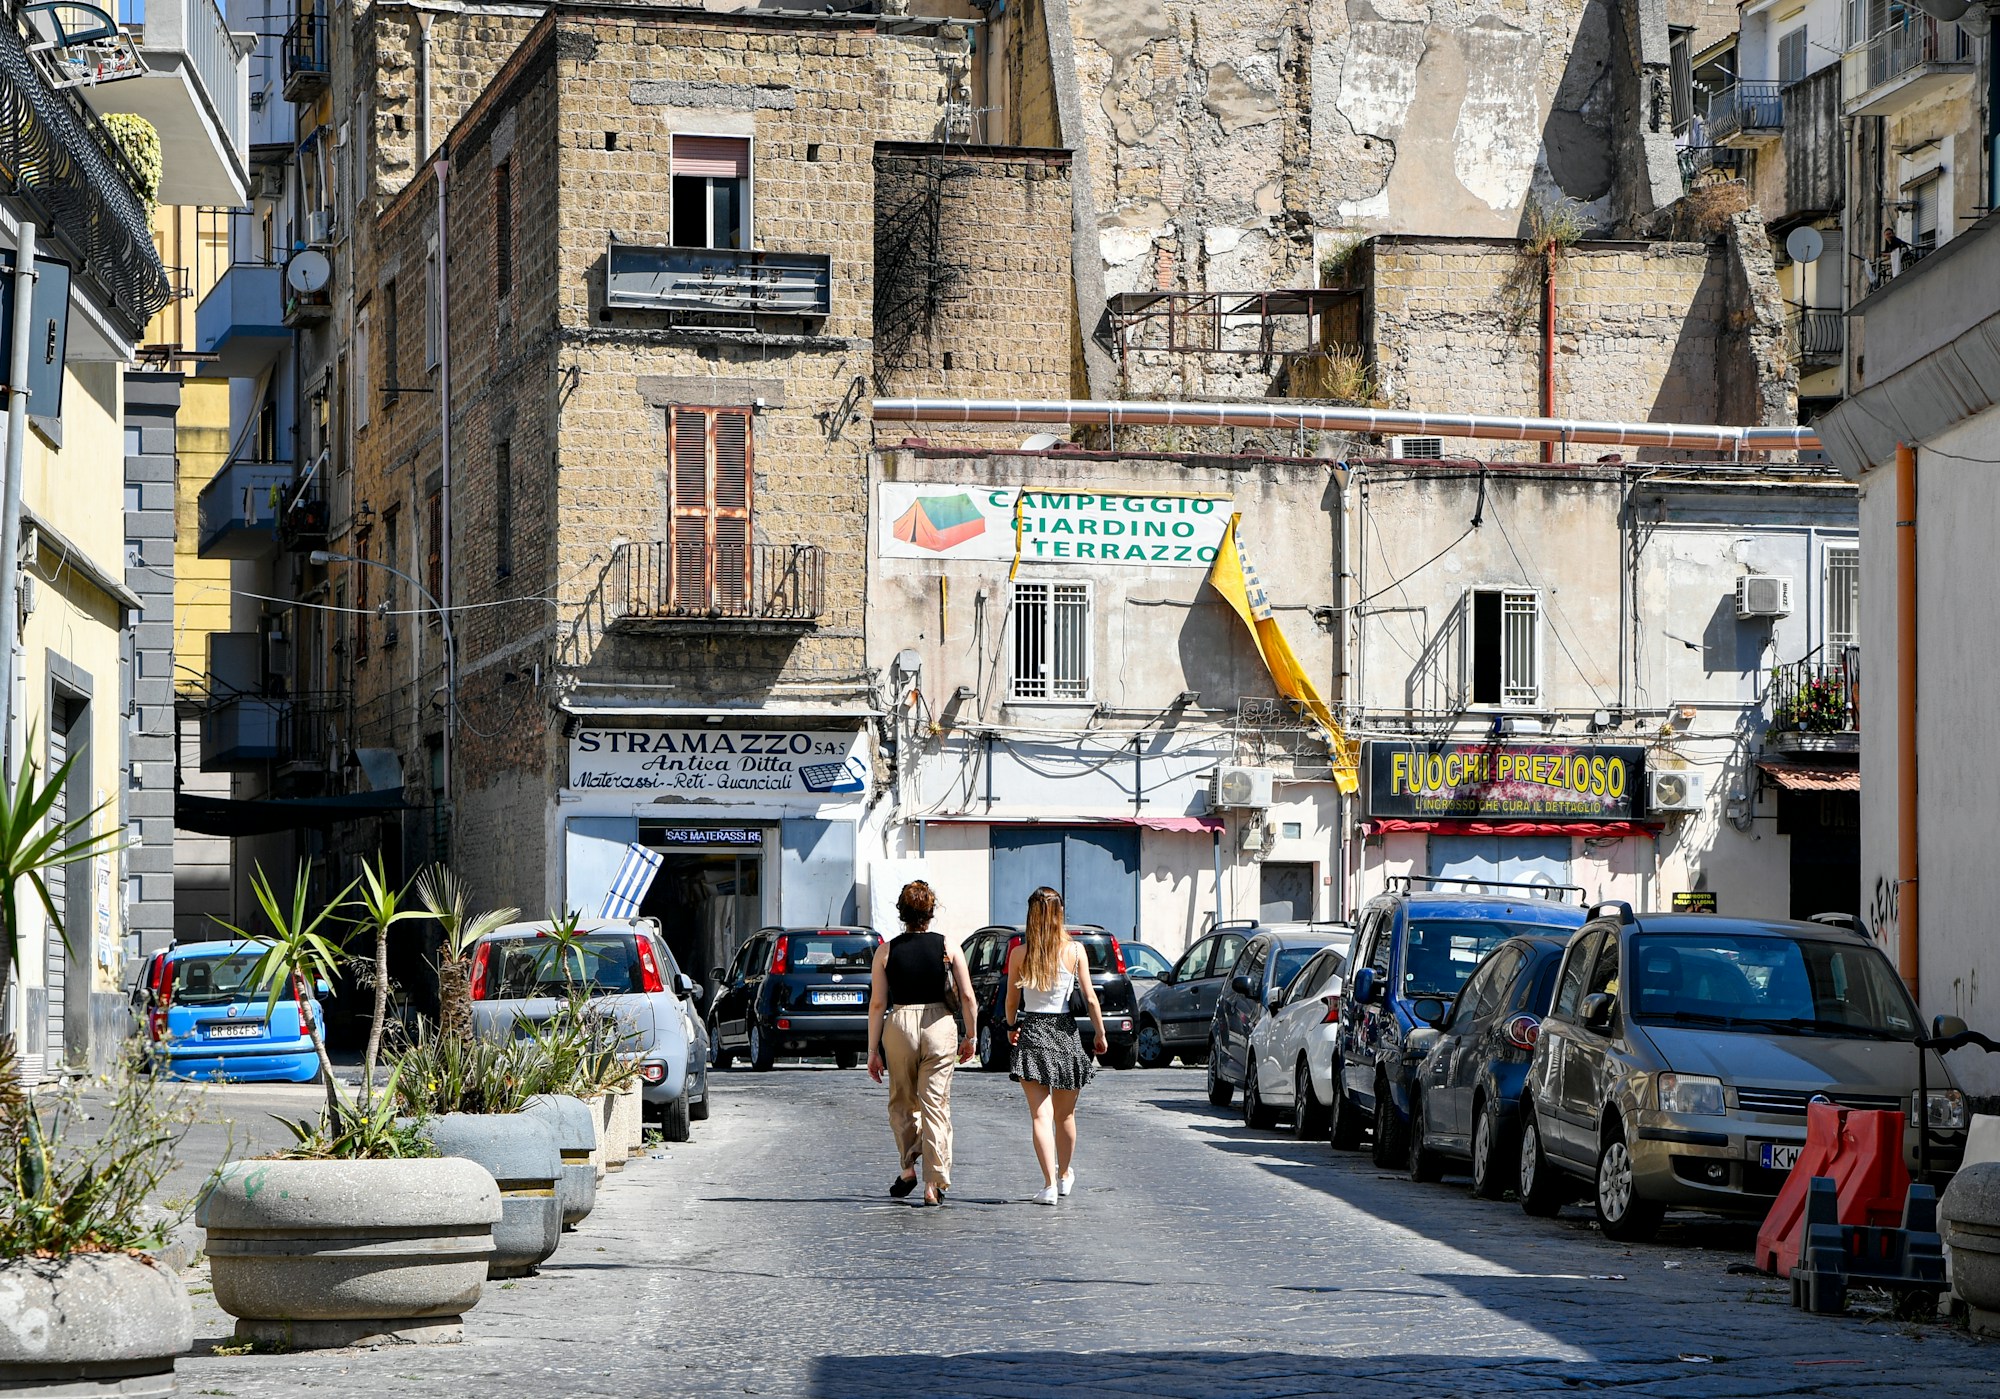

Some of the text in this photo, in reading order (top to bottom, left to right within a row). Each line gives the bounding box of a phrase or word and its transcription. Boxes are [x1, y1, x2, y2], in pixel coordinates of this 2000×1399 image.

[988, 491, 1214, 514] CAMPEGGIO
[1010, 516, 1195, 538] GIARDINO
[1031, 541, 1219, 562] TERRAZZO
[578, 731, 812, 755] STRAMAZZO
[641, 754, 794, 772] Antica Ditta
[674, 772, 707, 789] Reti
[717, 773, 792, 790] Guanciali
[1391, 752, 1625, 798] FUOCHI PREZIOSO
[1480, 800, 1499, 811] CHE
[1502, 801, 1530, 812] CURA
[1533, 801, 1542, 812] IL
[1545, 801, 1601, 813] DETTAGLIO
[690, 831, 747, 841] MATERASSI
[212, 1026, 223, 1037] CR
